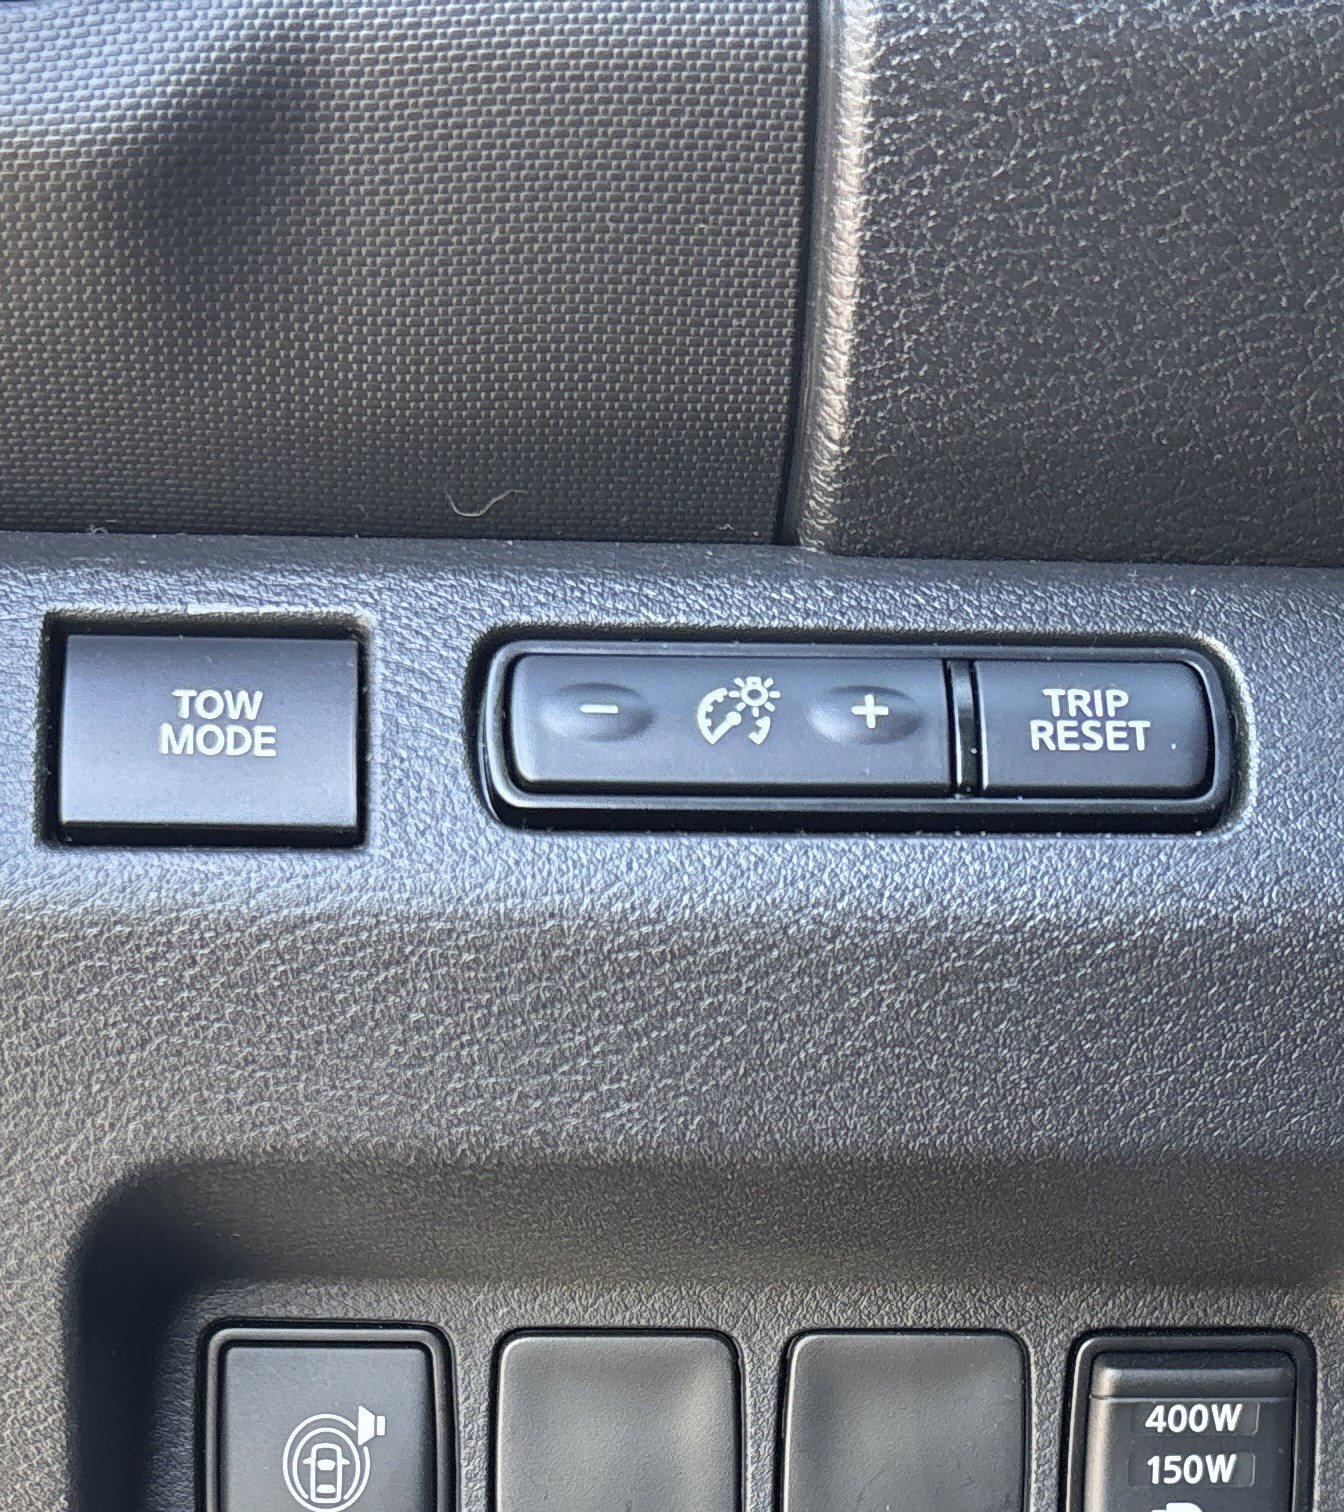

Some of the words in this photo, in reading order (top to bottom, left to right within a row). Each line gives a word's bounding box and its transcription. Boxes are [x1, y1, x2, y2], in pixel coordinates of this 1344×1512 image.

[171, 688, 264, 721] TOW
[1041, 687, 1129, 718] TRIP
[158, 722, 277, 757] MODE
[1029, 719, 1151, 752] RESET
[1144, 1403, 1243, 1433] 400W
[1146, 1454, 1237, 1485] 150W
